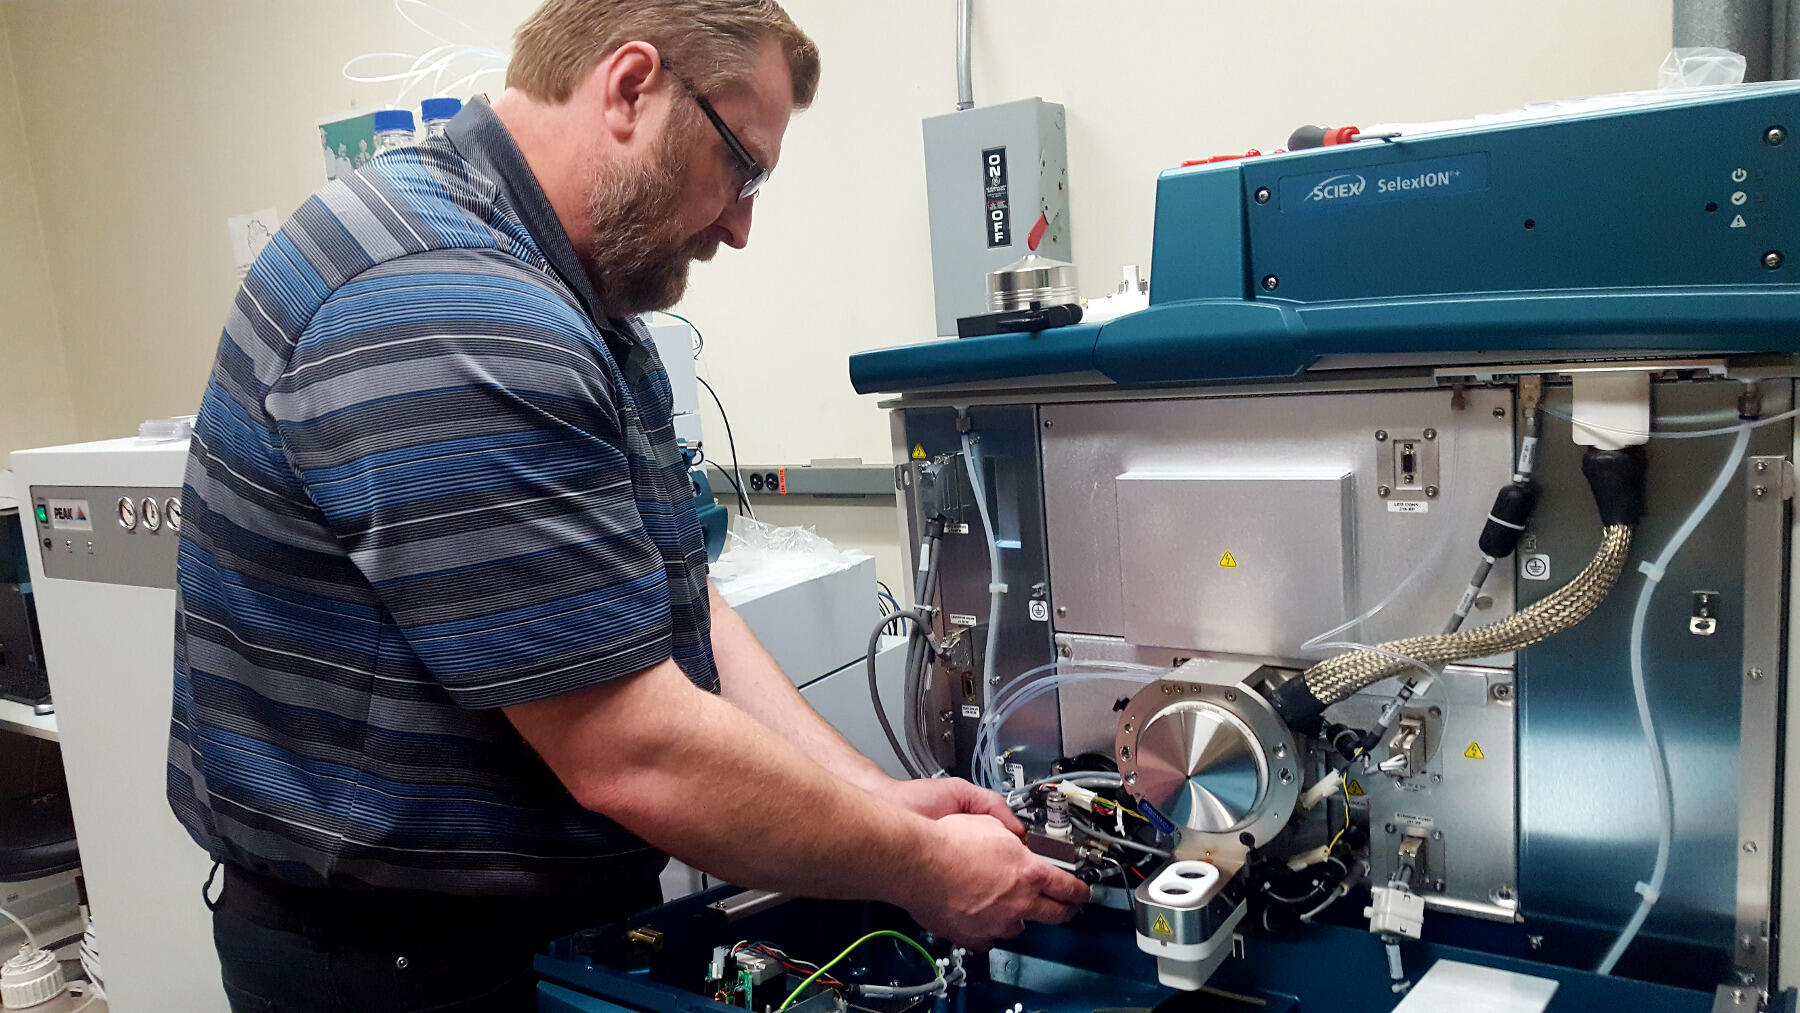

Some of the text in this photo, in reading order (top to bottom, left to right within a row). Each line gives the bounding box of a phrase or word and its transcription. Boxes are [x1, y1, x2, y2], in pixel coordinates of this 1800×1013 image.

[988, 154, 1001, 177] ON
[1313, 182, 1361, 201] SCIEX
[991, 210, 1004, 243] OFF
[54, 507, 73, 520] PEAK
